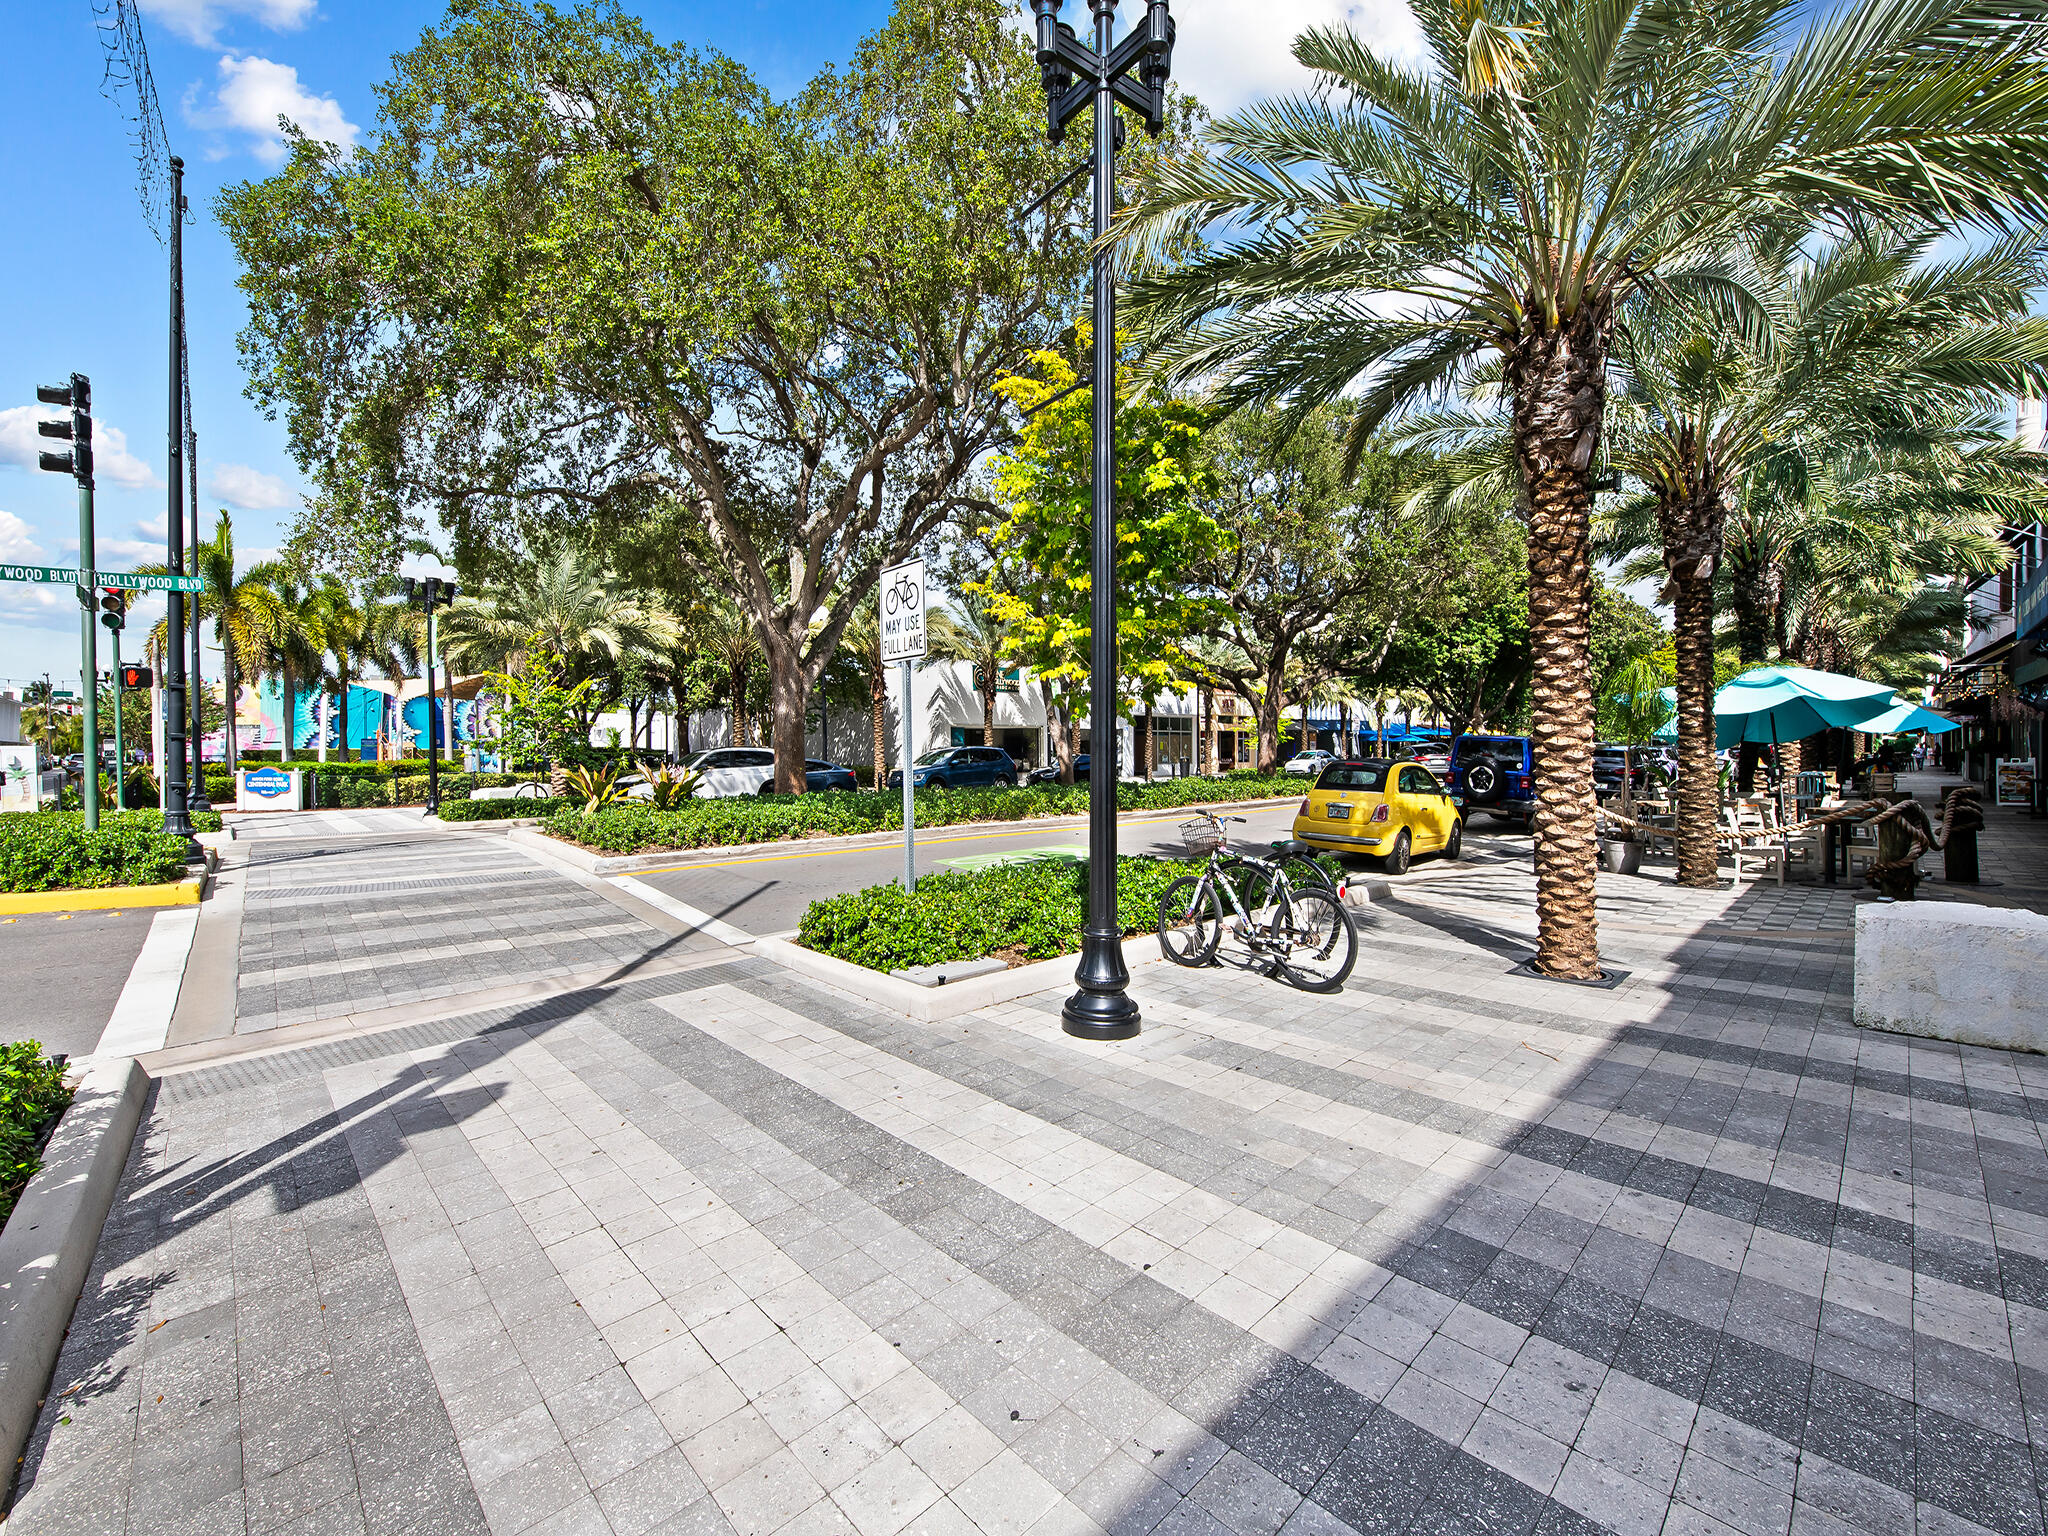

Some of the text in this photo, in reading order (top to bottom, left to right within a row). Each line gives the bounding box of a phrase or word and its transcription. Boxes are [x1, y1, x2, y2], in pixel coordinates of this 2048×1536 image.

[50, 569, 76, 583] BLVD
[99, 574, 202, 590] HOLLYWOOD BLVD
[886, 614, 920, 635] MAY USE
[884, 634, 923, 655] FULL LANE
